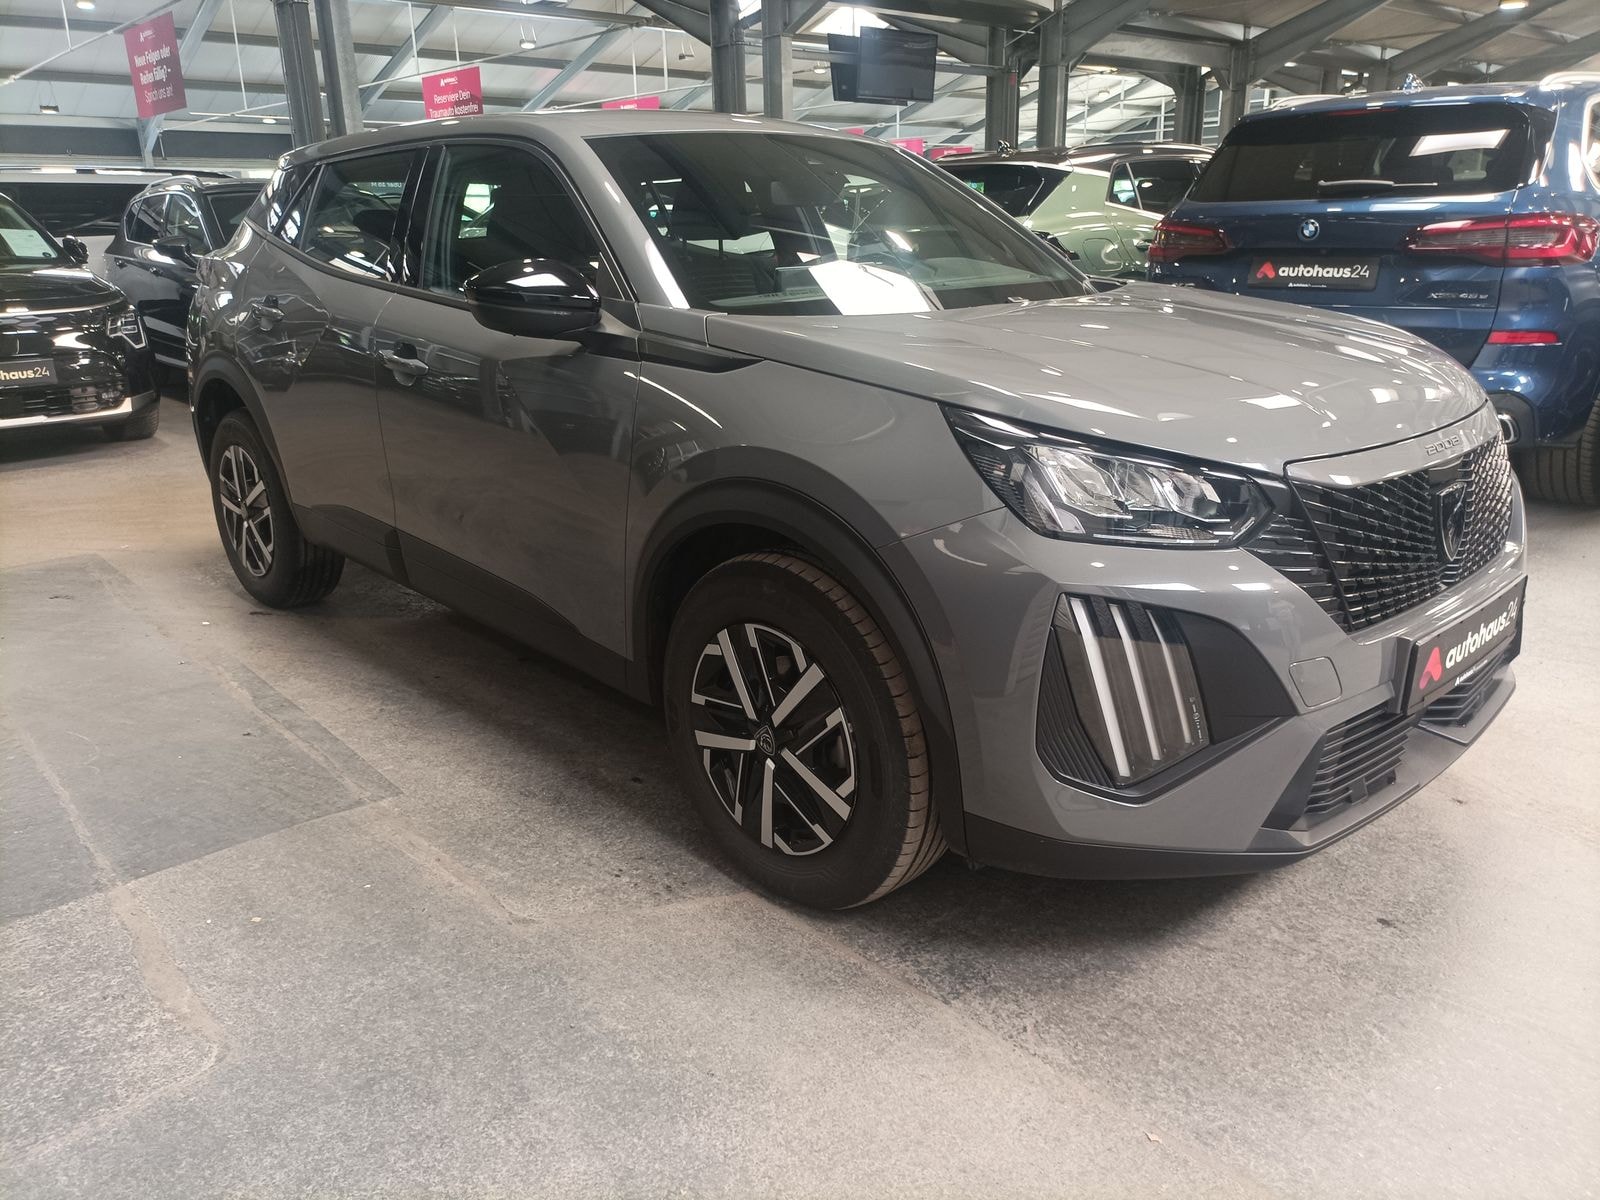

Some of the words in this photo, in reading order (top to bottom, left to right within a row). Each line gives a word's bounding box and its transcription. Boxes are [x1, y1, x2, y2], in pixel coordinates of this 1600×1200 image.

[145, 49, 160, 65] Felgen
[160, 44, 170, 59] oder
[434, 91, 459, 104] Reserviere
[459, 89, 470, 101] Dein
[429, 107, 454, 118] Traumauto
[1278, 264, 1370, 278] autohaus24
[0, 366, 50, 380] haus24
[1424, 434, 1460, 456] 2008
[1445, 597, 1518, 669] autohaus24
